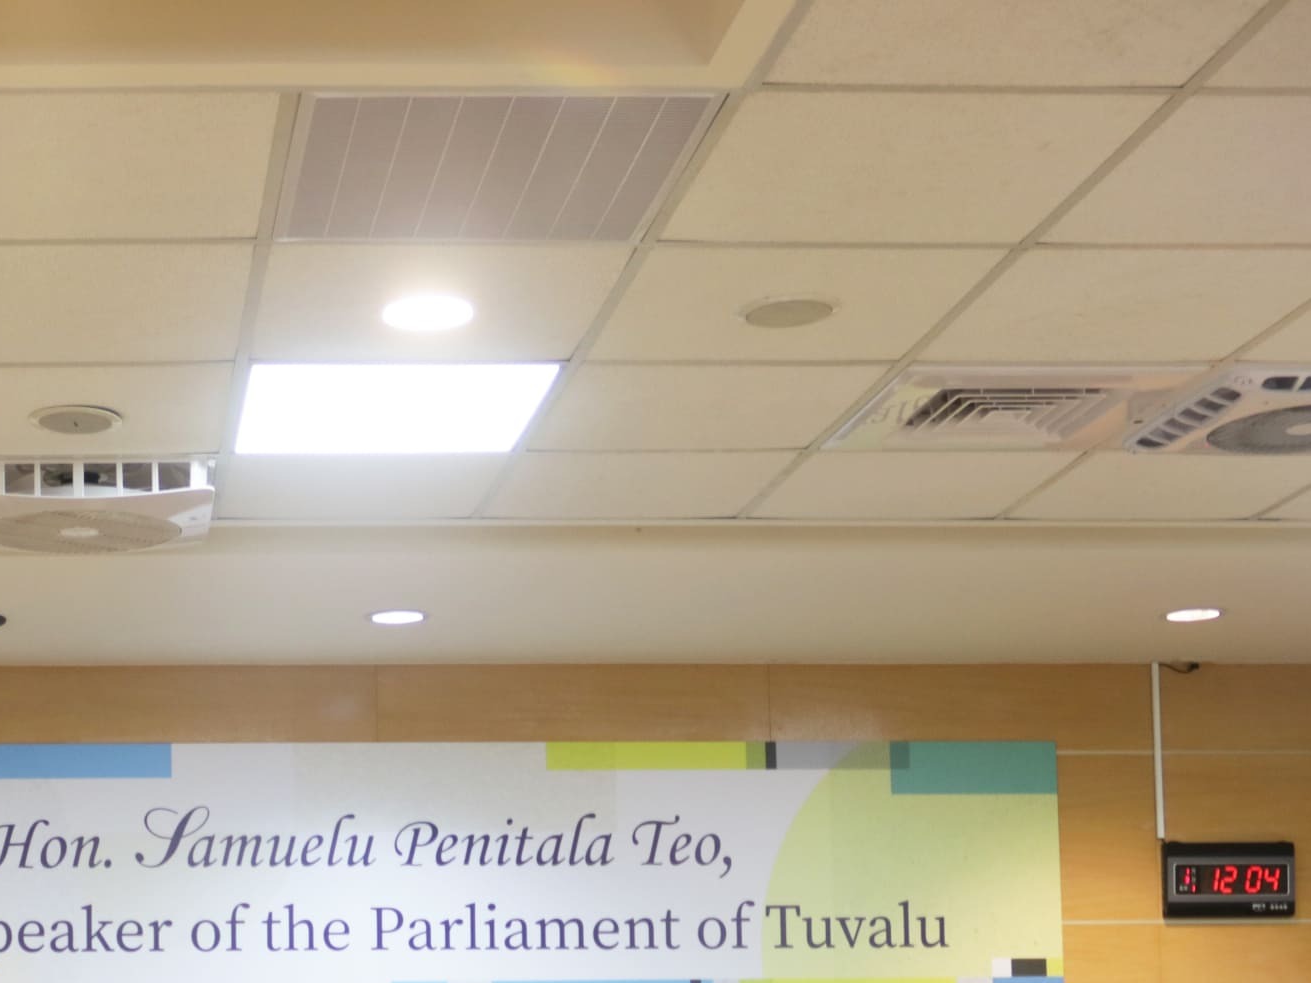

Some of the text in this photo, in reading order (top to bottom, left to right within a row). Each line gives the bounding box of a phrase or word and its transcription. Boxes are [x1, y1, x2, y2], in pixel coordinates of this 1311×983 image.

[135, 806, 374, 867] Samuelu
[394, 813, 614, 866] Penitala
[632, 815, 732, 878] Teo,
[190, 903, 250, 952] of
[261, 903, 351, 952] the
[371, 902, 680, 952] Parliament
[697, 900, 754, 951] of
[765, 902, 950, 950] Tuvalu
